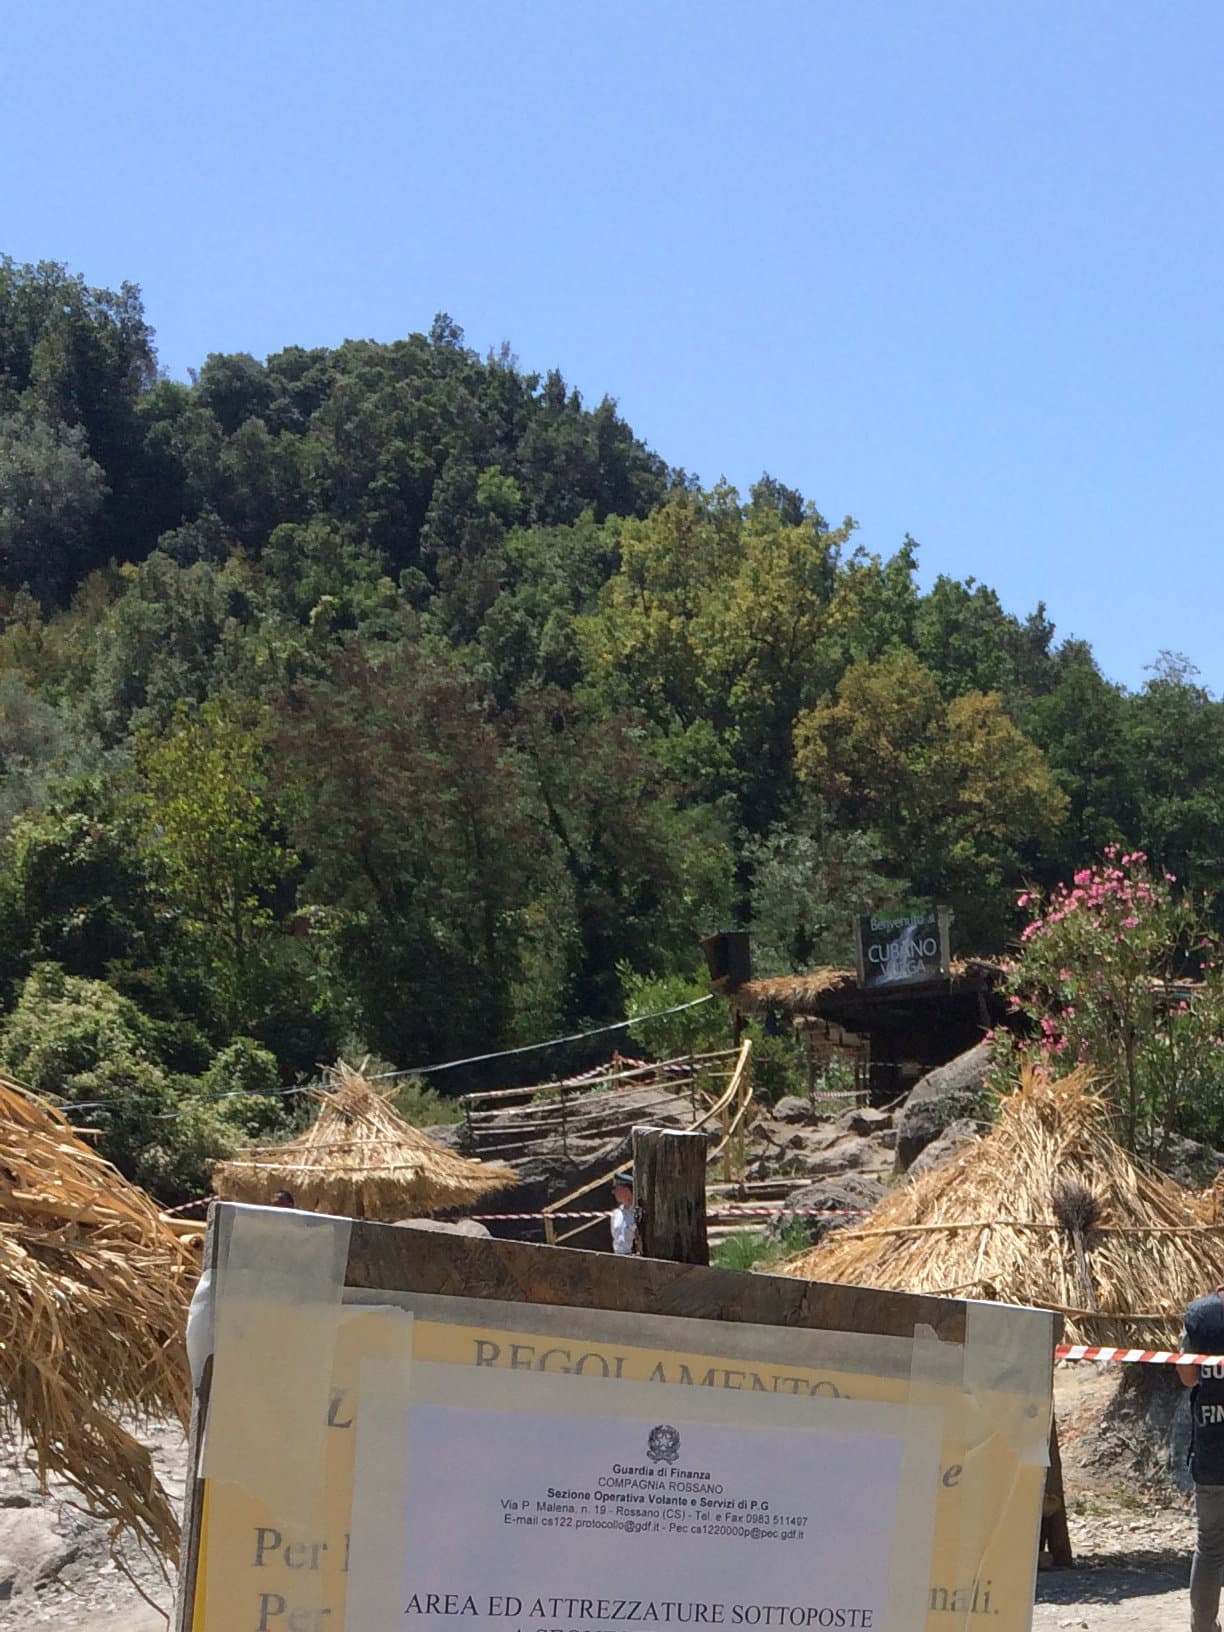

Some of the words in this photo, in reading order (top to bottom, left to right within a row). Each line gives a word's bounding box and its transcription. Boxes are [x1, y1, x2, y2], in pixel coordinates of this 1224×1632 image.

[868, 938, 937, 963] CUBANO
[612, 1464, 655, 1477] Guardia
[657, 1467, 667, 1477] di
[670, 1468, 711, 1481] Finanza
[598, 1477, 666, 1491] COMPAGNIA
[668, 1480, 723, 1495] ROSSANO
[547, 1487, 591, 1500] Sezione
[594, 1491, 645, 1504] Operativa
[648, 1494, 688, 1507] Volante
[690, 1498, 697, 1507] e
[700, 1497, 735, 1509] Servizi
[737, 1500, 748, 1511] di
[500, 1499, 519, 1511] Via
[595, 1504, 607, 1515] 19
[616, 1506, 660, 1518] Rossano
[662, 1508, 686, 1522] (CS)
[715, 1513, 722, 1522] e
[725, 1511, 744, 1523] Fax
[746, 1513, 770, 1525] 0983
[504, 1513, 539, 1526] E-mail
[668, 1522, 688, 1534] Pec
[252, 1526, 329, 1571] Per
[404, 1593, 480, 1616] AREA
[488, 1596, 522, 1617] ED
[528, 1598, 725, 1624] ATTREZZATURE
[731, 1604, 873, 1628] SOTTOPOSTE
